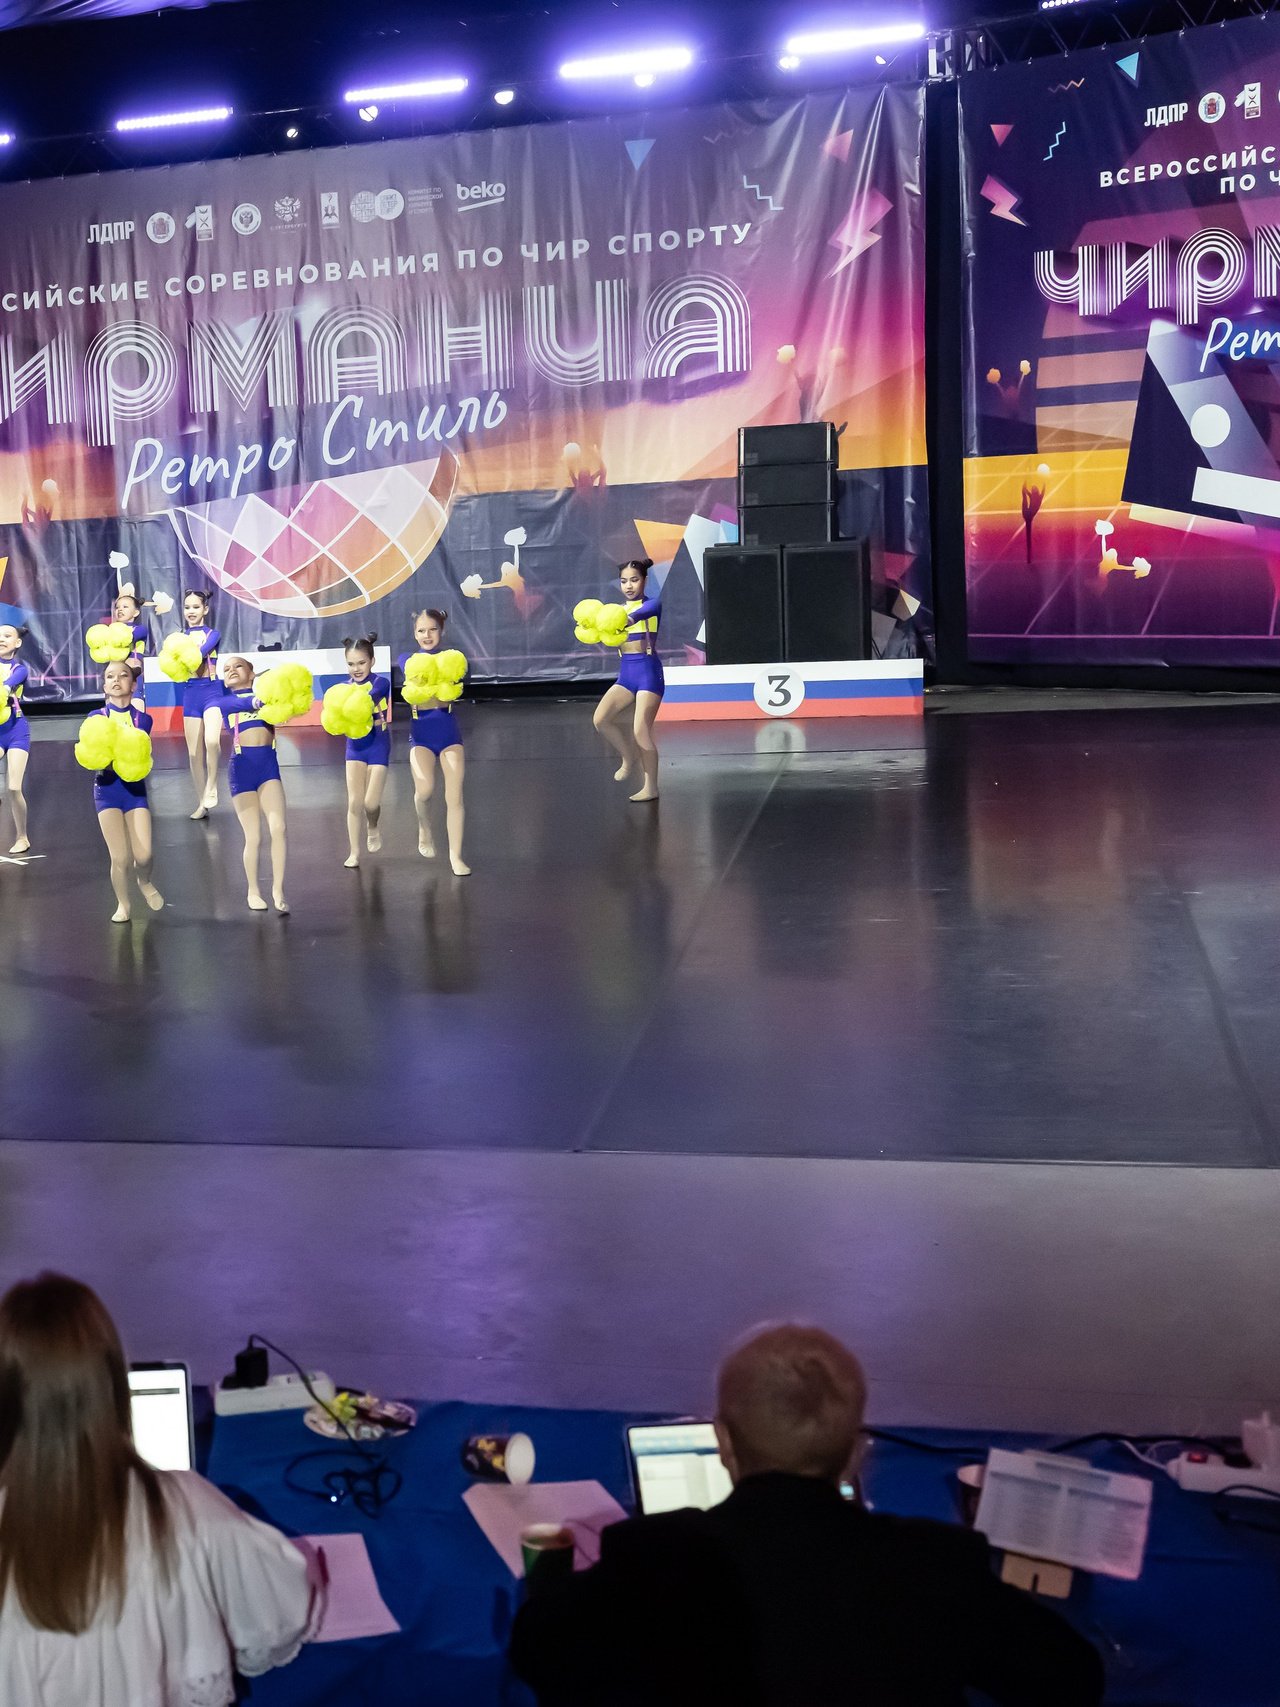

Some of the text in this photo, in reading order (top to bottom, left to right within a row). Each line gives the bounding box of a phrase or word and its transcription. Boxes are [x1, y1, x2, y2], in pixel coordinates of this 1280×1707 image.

[1144, 102, 1188, 127] ЛДПР
[1100, 145, 1276, 187] ВСЕРОССИЙС
[456, 181, 506, 200] beko
[1220, 173, 1256, 194] ПО
[87, 221, 135, 244] ЛДПР
[165, 252, 439, 297] СОРЕВНОВАНИЯ
[457, 247, 504, 269] ПО
[520, 239, 591, 262] ЧИР
[608, 222, 752, 256] СПОРТУ
[120, 391, 509, 509] Ретро Стиль
[766, 674, 792, 707] 3
